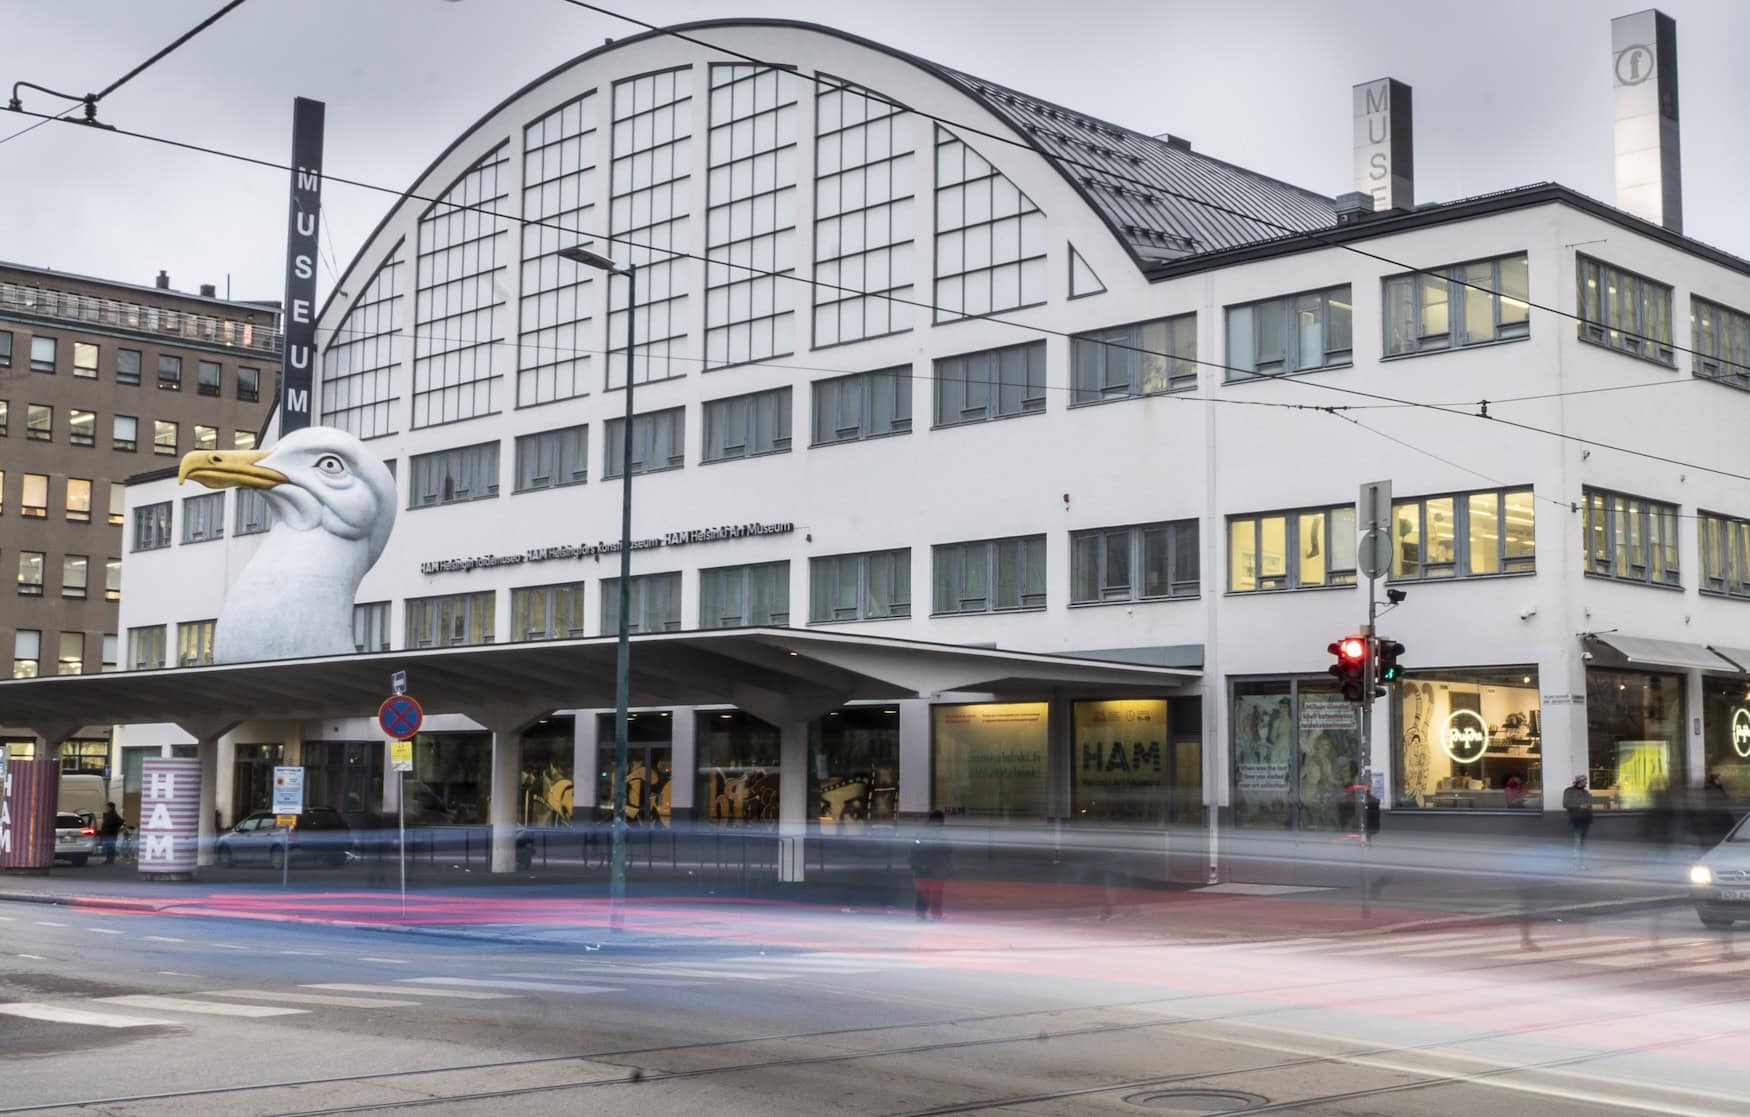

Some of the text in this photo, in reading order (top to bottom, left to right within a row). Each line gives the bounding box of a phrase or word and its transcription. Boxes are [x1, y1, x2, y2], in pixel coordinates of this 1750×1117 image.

[287, 167, 319, 412] MUSEUM
[420, 562, 440, 574] HAM
[527, 549, 546, 561] HAM
[598, 538, 661, 555] konstseum
[665, 532, 689, 546] HAM
[690, 525, 729, 544] Helsinki
[730, 525, 746, 538] Art
[747, 522, 793, 537] Museum
[1083, 742, 1160, 771] HAM
[145, 773, 174, 860] HAM
